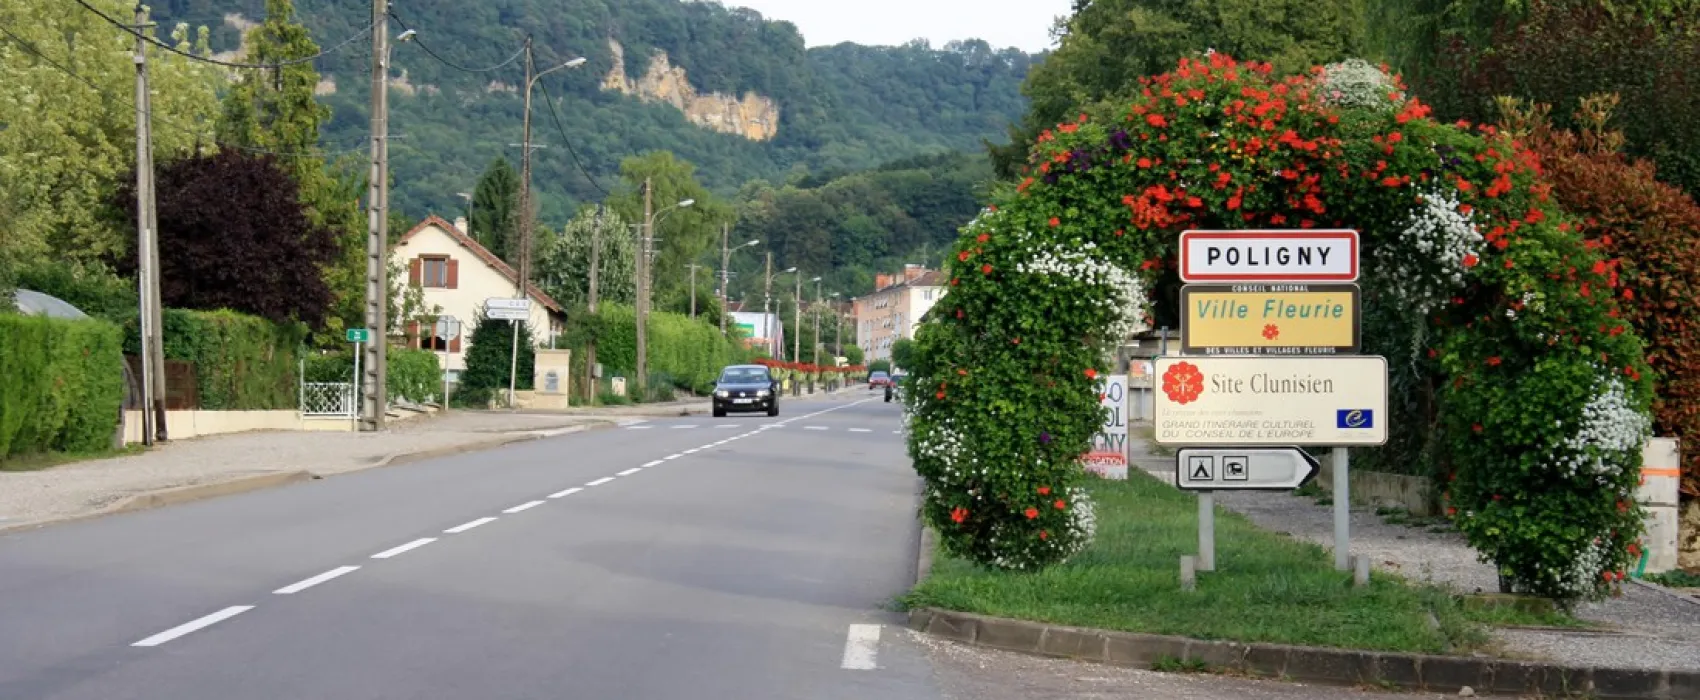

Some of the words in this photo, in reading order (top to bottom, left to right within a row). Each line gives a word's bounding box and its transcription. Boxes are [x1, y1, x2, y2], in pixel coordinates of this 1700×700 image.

[1207, 246, 1332, 266] POLIGNY
[1232, 285, 1267, 293] CONSEIL
[1271, 285, 1309, 293] NATIONAL
[1197, 299, 1249, 319] Ville
[1262, 299, 1344, 319] Fleurie
[1206, 346, 1221, 355] DES
[1223, 346, 1250, 355] VILLES
[1252, 346, 1262, 355] ET
[1265, 346, 1301, 355] VILLAGES
[1303, 346, 1337, 355] FLEURIS
[1211, 373, 1244, 394] Site
[1249, 372, 1334, 394] Clunisien
[1162, 420, 1200, 429] GRAND
[1262, 420, 1316, 429] CULTUREL
[1161, 429, 1180, 438] DU
[1185, 429, 1235, 438] CONSEIL
[1238, 429, 1252, 438] DE
[1257, 429, 1315, 438] L'EUROPE
